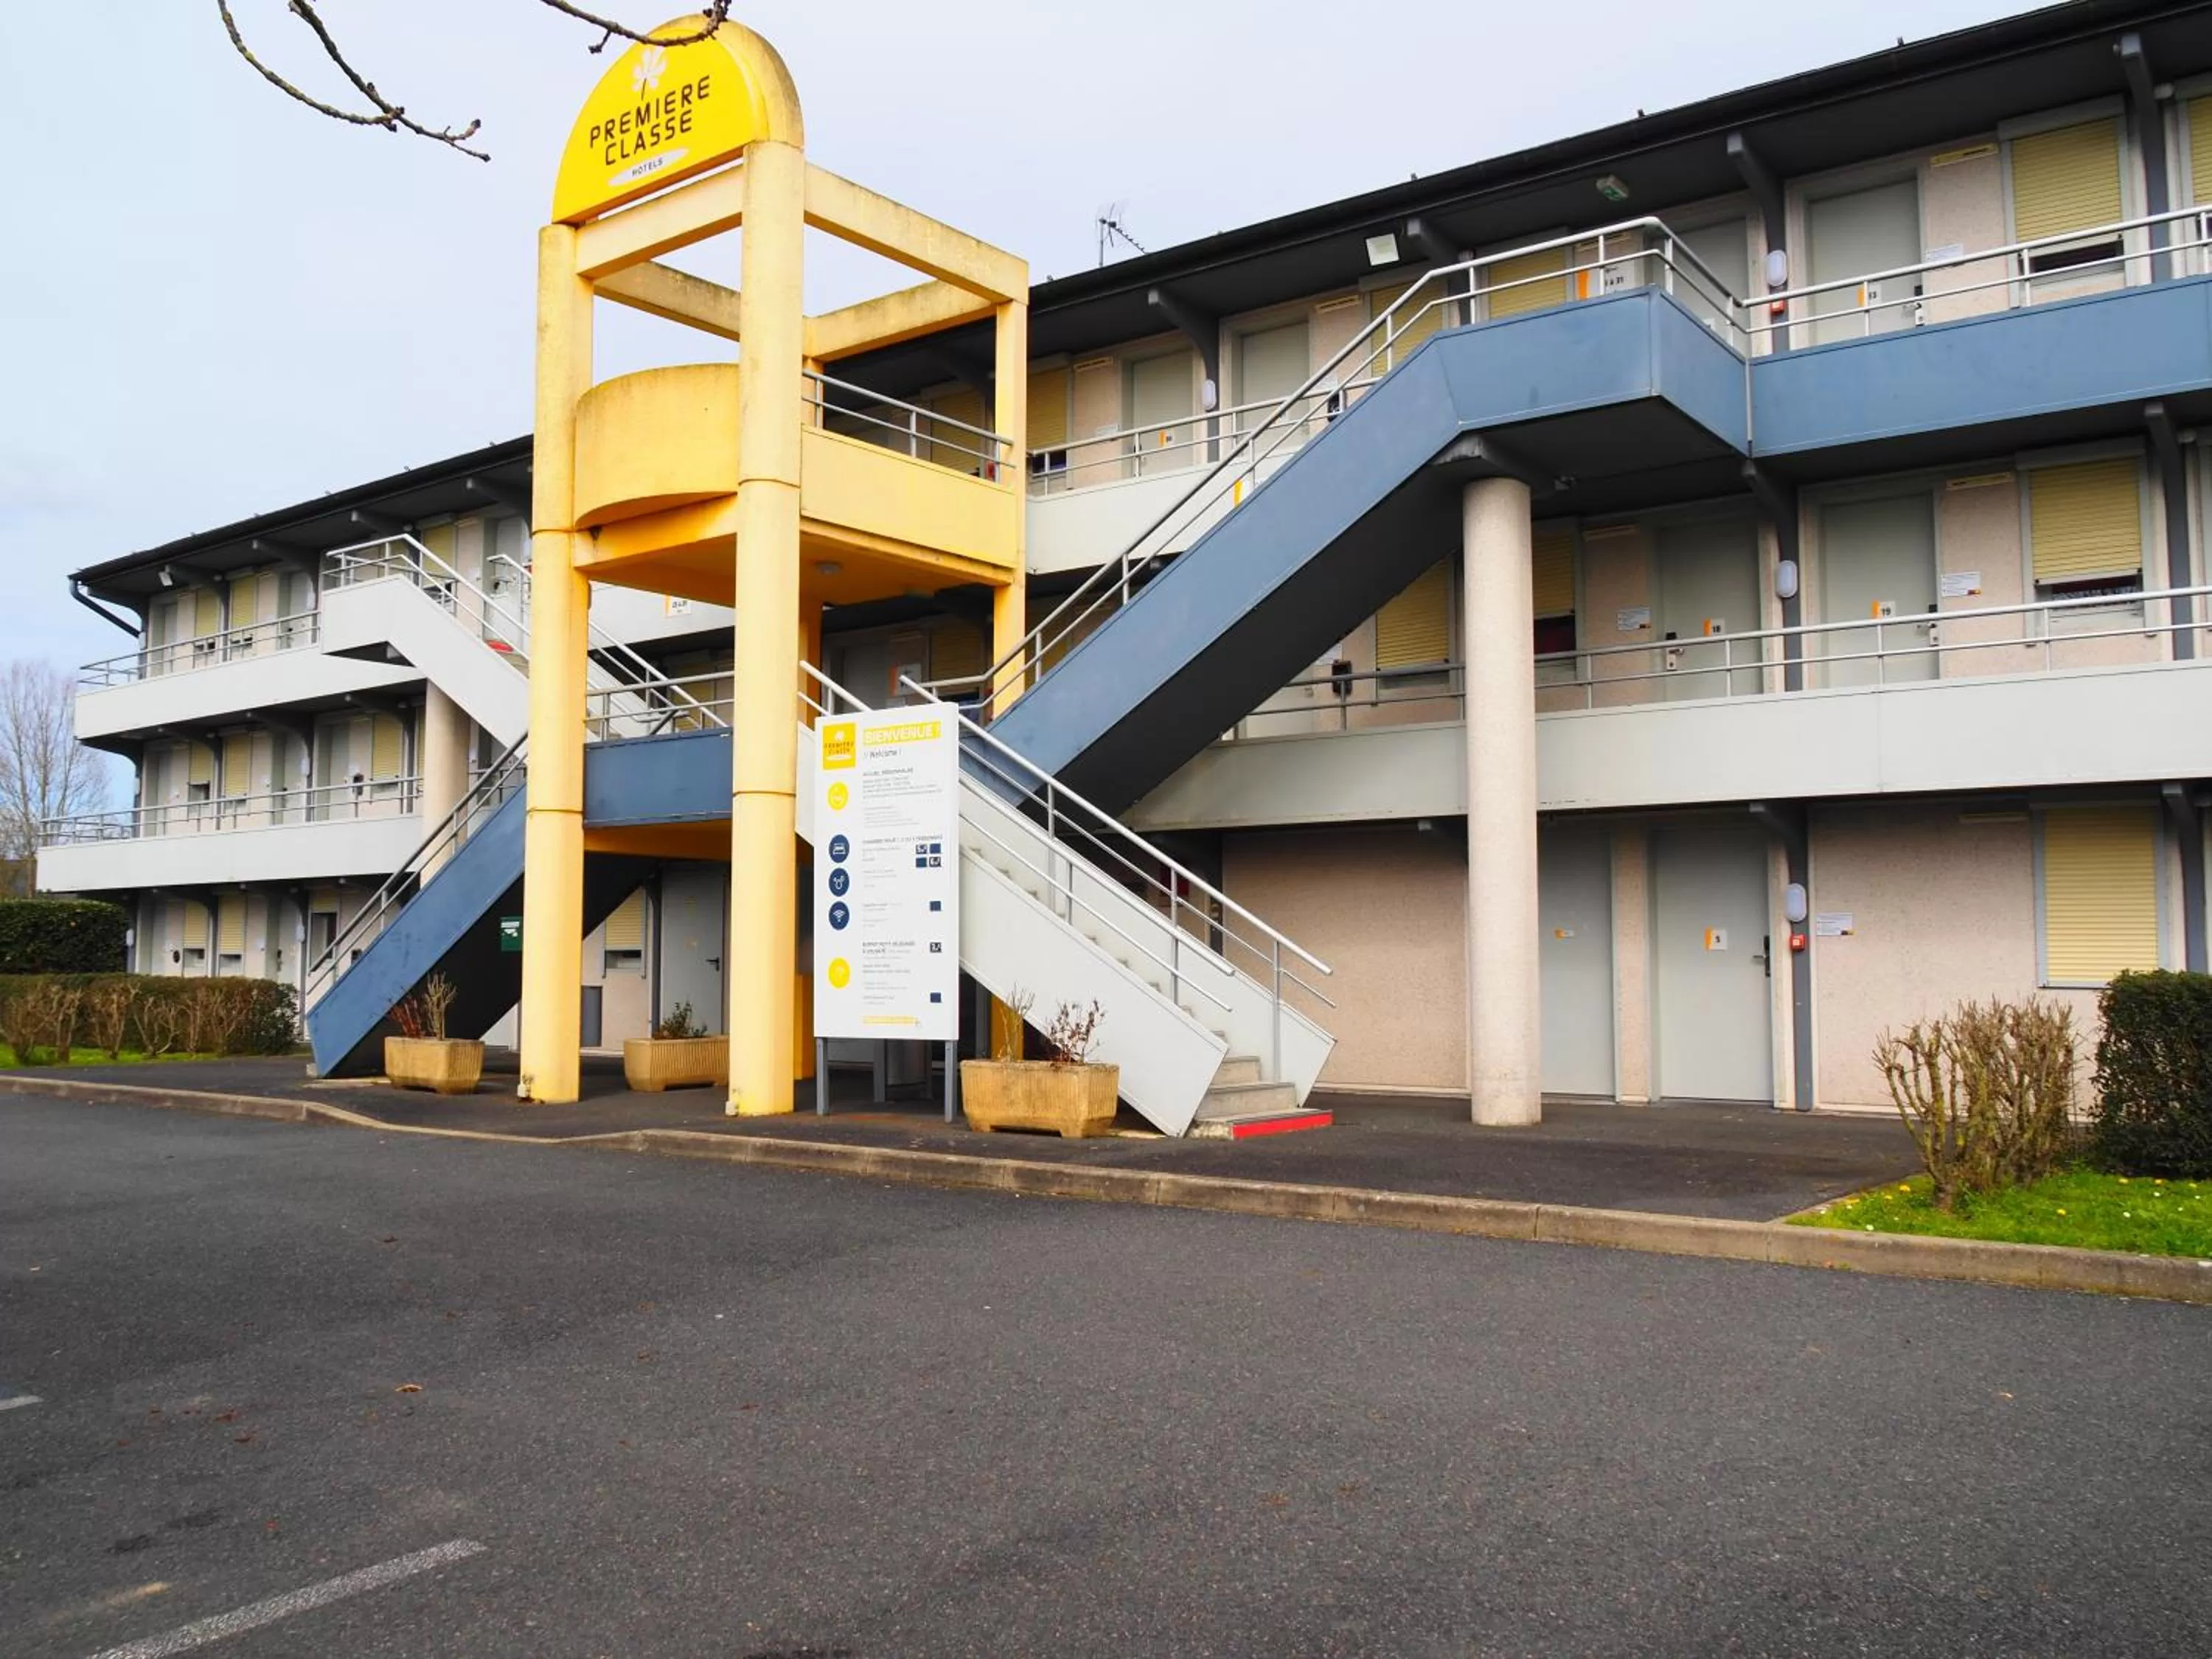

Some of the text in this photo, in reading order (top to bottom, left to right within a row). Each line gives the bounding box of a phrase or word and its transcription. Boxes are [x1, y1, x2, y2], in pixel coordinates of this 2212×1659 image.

[590, 75, 710, 148] PREMIERE
[605, 109, 693, 166] CLASSE
[631, 157, 664, 177] HOTELS
[864, 723, 933, 744] BIENVENUE
